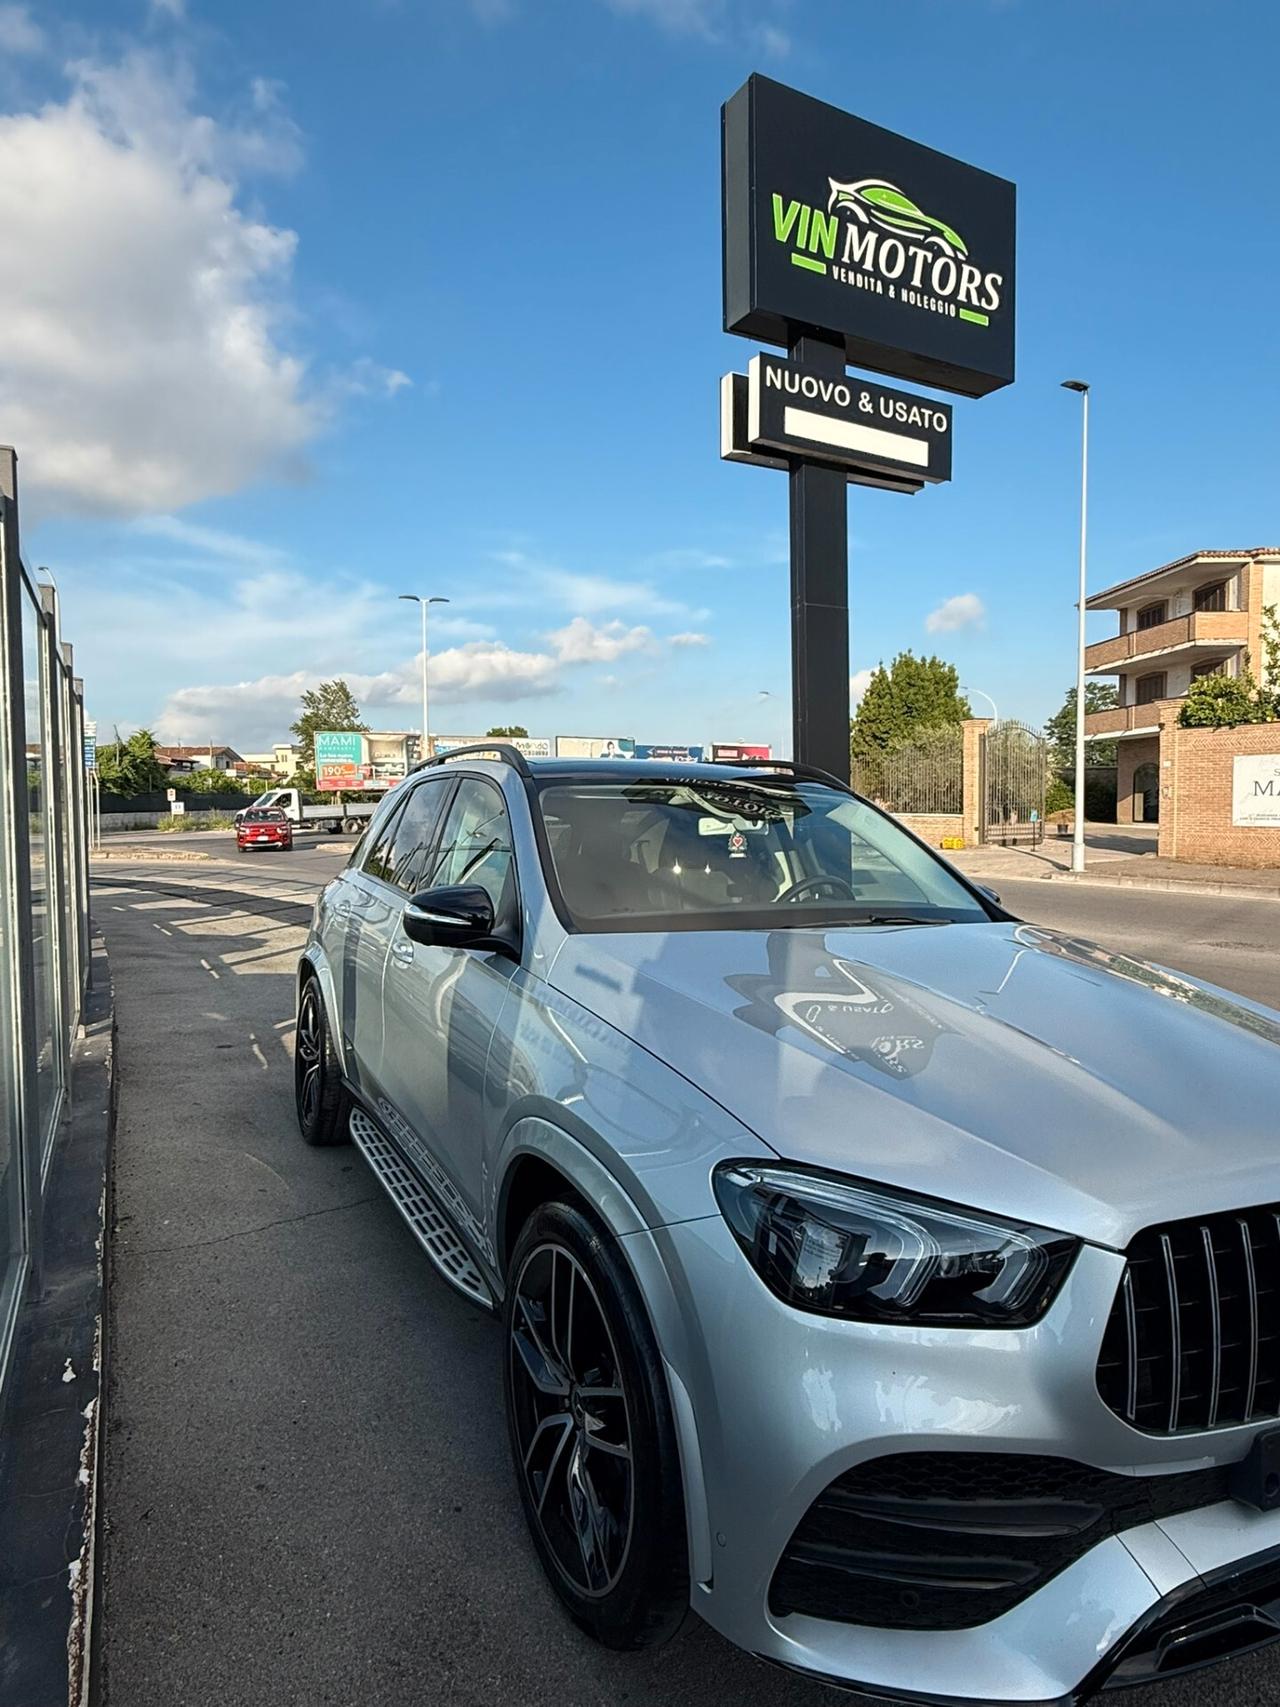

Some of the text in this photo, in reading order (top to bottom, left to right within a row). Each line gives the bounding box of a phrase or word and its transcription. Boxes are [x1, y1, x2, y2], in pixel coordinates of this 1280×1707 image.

[771, 192, 1003, 311] VIN MOTORS
[832, 264, 956, 318] VENDITA & NOLEGGIO
[765, 364, 948, 433] NUOVO & USATO
[319, 736, 356, 745] MAMI
[1253, 780, 1280, 796] M
